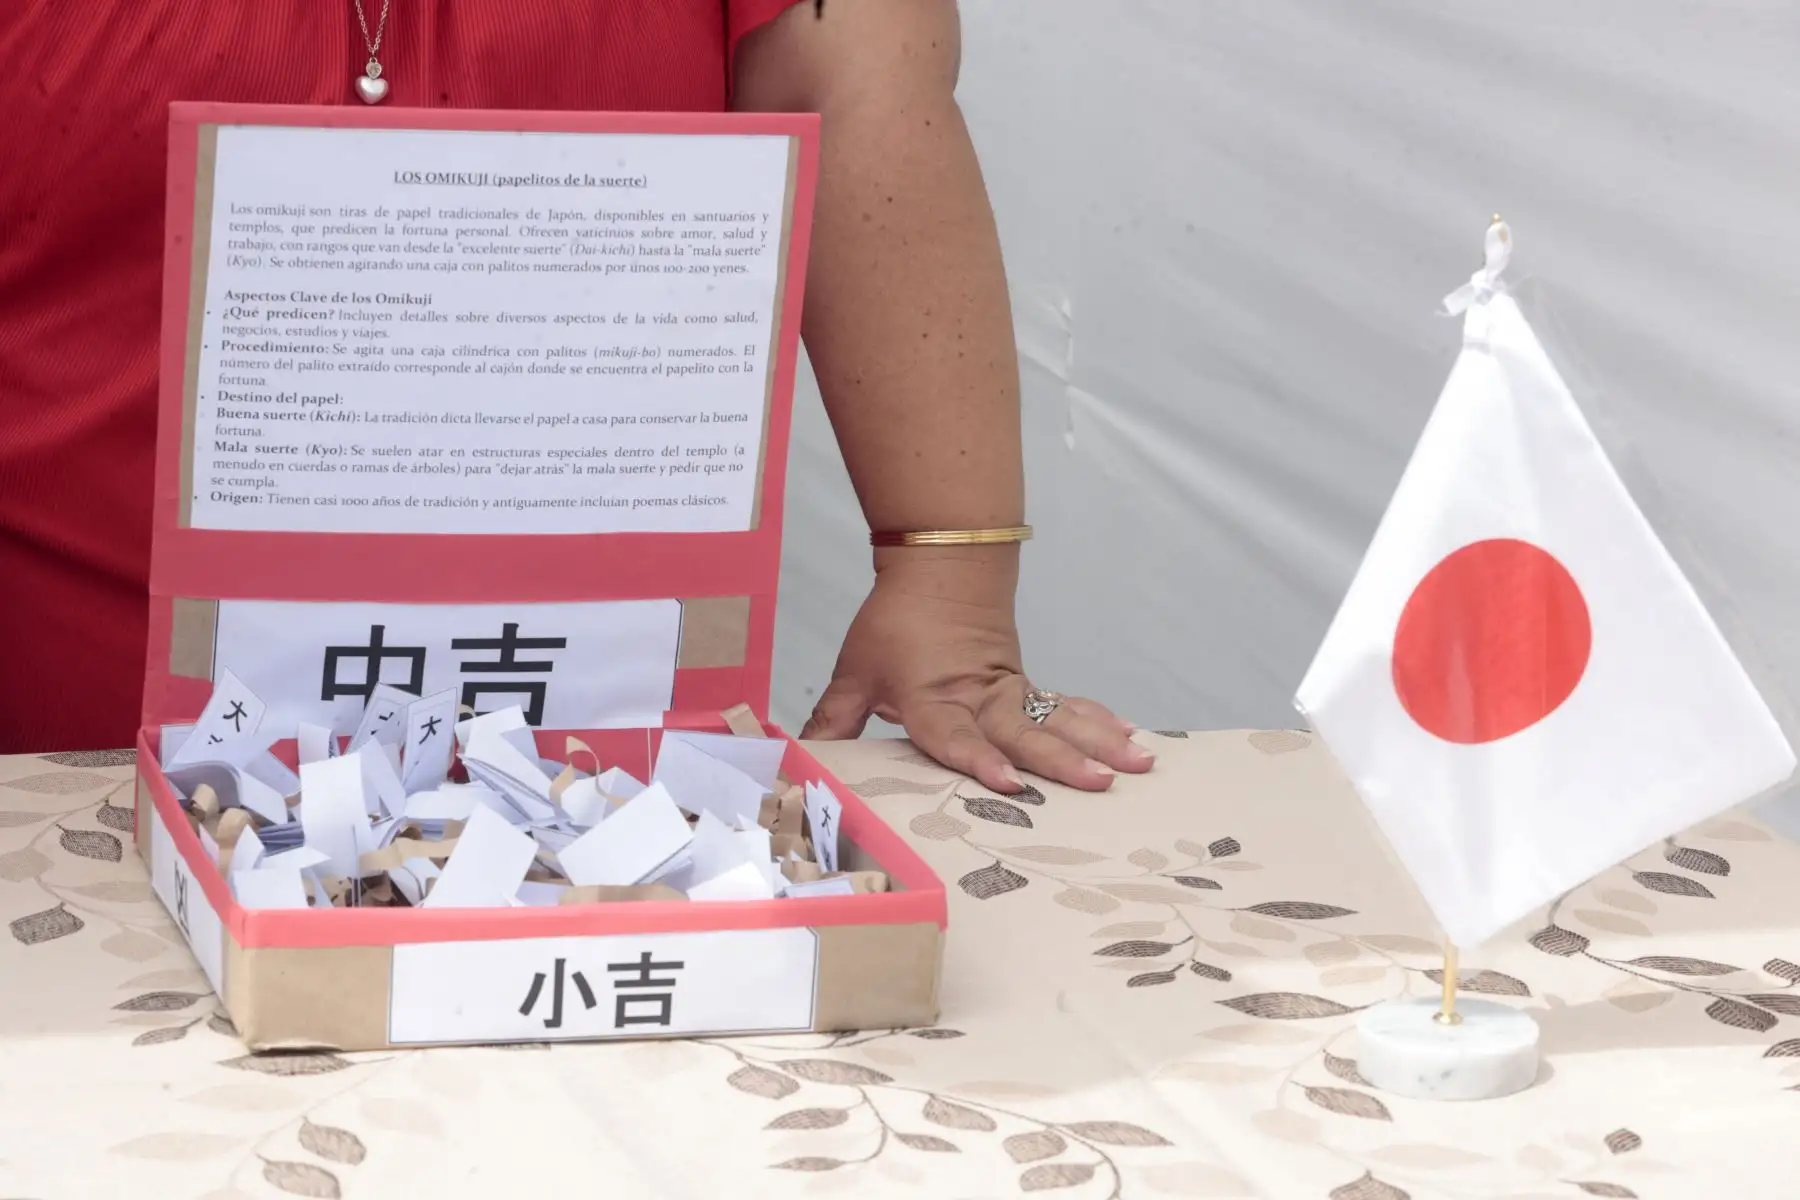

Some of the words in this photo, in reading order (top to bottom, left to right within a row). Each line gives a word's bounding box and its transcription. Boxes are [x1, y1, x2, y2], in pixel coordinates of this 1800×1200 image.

[393, 169, 422, 183] LOS
[425, 170, 489, 185] OMIKUJI
[492, 171, 562, 188] (papelitos
[563, 172, 581, 186] de
[583, 173, 596, 186] la
[598, 173, 648, 189] suerte)
[230, 202, 253, 215] Los
[255, 202, 306, 219] omikuji
[308, 207, 332, 216] son
[338, 205, 368, 217] tiras
[373, 204, 390, 217] de
[396, 204, 431, 220] papel
[438, 205, 519, 219] tradicionales
[525, 206, 541, 219] de
[593, 207, 665, 224] disponibles
[691, 210, 756, 223] santuarios
[289, 224, 315, 236] que
[321, 221, 378, 237] predicen
[401, 222, 449, 235] fortuna
[518, 223, 569, 237] Ofrecen
[575, 225, 635, 238] vaticinios
[640, 225, 675, 238] sobre
[722, 226, 755, 240] salud
[279, 242, 304, 251] con
[306, 242, 349, 255] rangos
[351, 243, 376, 255] que
[378, 243, 401, 252] van
[402, 240, 441, 253] desde
[638, 242, 671, 256] hasta
[268, 254, 285, 267] Se
[287, 255, 344, 269] obtienen
[406, 260, 431, 270] una
[432, 257, 458, 273] caja
[460, 261, 484, 271] con
[487, 258, 530, 274] palitos
[532, 258, 603, 272] numerados
[604, 263, 627, 275] por
[629, 263, 660, 273] unos
[223, 287, 287, 304] Aspectos
[289, 289, 329, 303] Clave
[330, 290, 349, 303] de
[351, 290, 372, 304] los
[374, 291, 432, 308] Omikuji
[221, 305, 260, 321] ¿Qué
[265, 306, 336, 322] predicen?
[399, 308, 449, 321] detalles
[455, 309, 490, 322] sobre
[495, 309, 547, 323] diversos
[552, 311, 606, 326] aspectos
[612, 310, 628, 323] de
[651, 311, 678, 324] vida
[683, 315, 718, 324] como
[284, 323, 340, 337] estudios
[220, 338, 329, 354] Procedimiento:
[331, 341, 347, 354] Se
[352, 343, 384, 358] agita
[391, 346, 414, 355] una
[420, 343, 445, 359] caja
[516, 348, 539, 357] con
[545, 344, 587, 360] palitos
[743, 344, 755, 357] El
[219, 355, 270, 369] número
[273, 357, 294, 370] del
[297, 357, 336, 374] palito
[393, 359, 472, 376] corresponde
[489, 360, 524, 376] cajón
[526, 360, 567, 374] donde
[585, 362, 648, 374] encuentra
[665, 361, 715, 377] papelito
[717, 365, 740, 374] con
[217, 388, 273, 403] Destino
[274, 390, 298, 404] del
[300, 391, 344, 408] papel:
[215, 406, 260, 420] Buena
[262, 408, 307, 421] suerte
[309, 408, 360, 425] (Kichi):
[364, 409, 379, 422] La
[381, 409, 438, 423] tradición
[440, 410, 471, 423] dicta
[474, 410, 521, 424] llevarse
[536, 411, 570, 427] papel
[581, 415, 608, 424] casa
[610, 415, 636, 427] para
[639, 414, 697, 424] conservar
[712, 410, 748, 423] buena
[213, 439, 248, 453] Mala
[254, 442, 299, 454] suerte
[305, 441, 348, 458] (Kyo):
[349, 442, 365, 455] Se
[371, 442, 412, 456] suelen
[417, 444, 444, 456] atar
[471, 445, 542, 457] estructuras
[546, 444, 608, 460] especiales
[613, 444, 655, 457] dentro
[660, 444, 680, 457] del
[686, 444, 728, 460] templo
[212, 457, 266, 471] menudo
[287, 458, 336, 472] cuerdas
[351, 463, 389, 473] ramas
[391, 460, 408, 473] de
[410, 460, 461, 476] árboles)
[464, 464, 491, 476] para
[586, 461, 616, 474] mala
[618, 462, 656, 474] suerte
[669, 460, 700, 476] pedir
[703, 464, 725, 476] que
[209, 490, 263, 507] Origen:
[267, 491, 310, 505] Tienen
[313, 493, 338, 505] casi
[340, 496, 369, 506] 1000
[371, 493, 403, 506] años
[403, 493, 420, 506] de
[422, 493, 479, 507] tradición
[492, 495, 577, 510] antiguamente
[631, 497, 679, 510] poemas
[321, 622, 567, 726] 中吉
[518, 951, 685, 1029] 小吉
